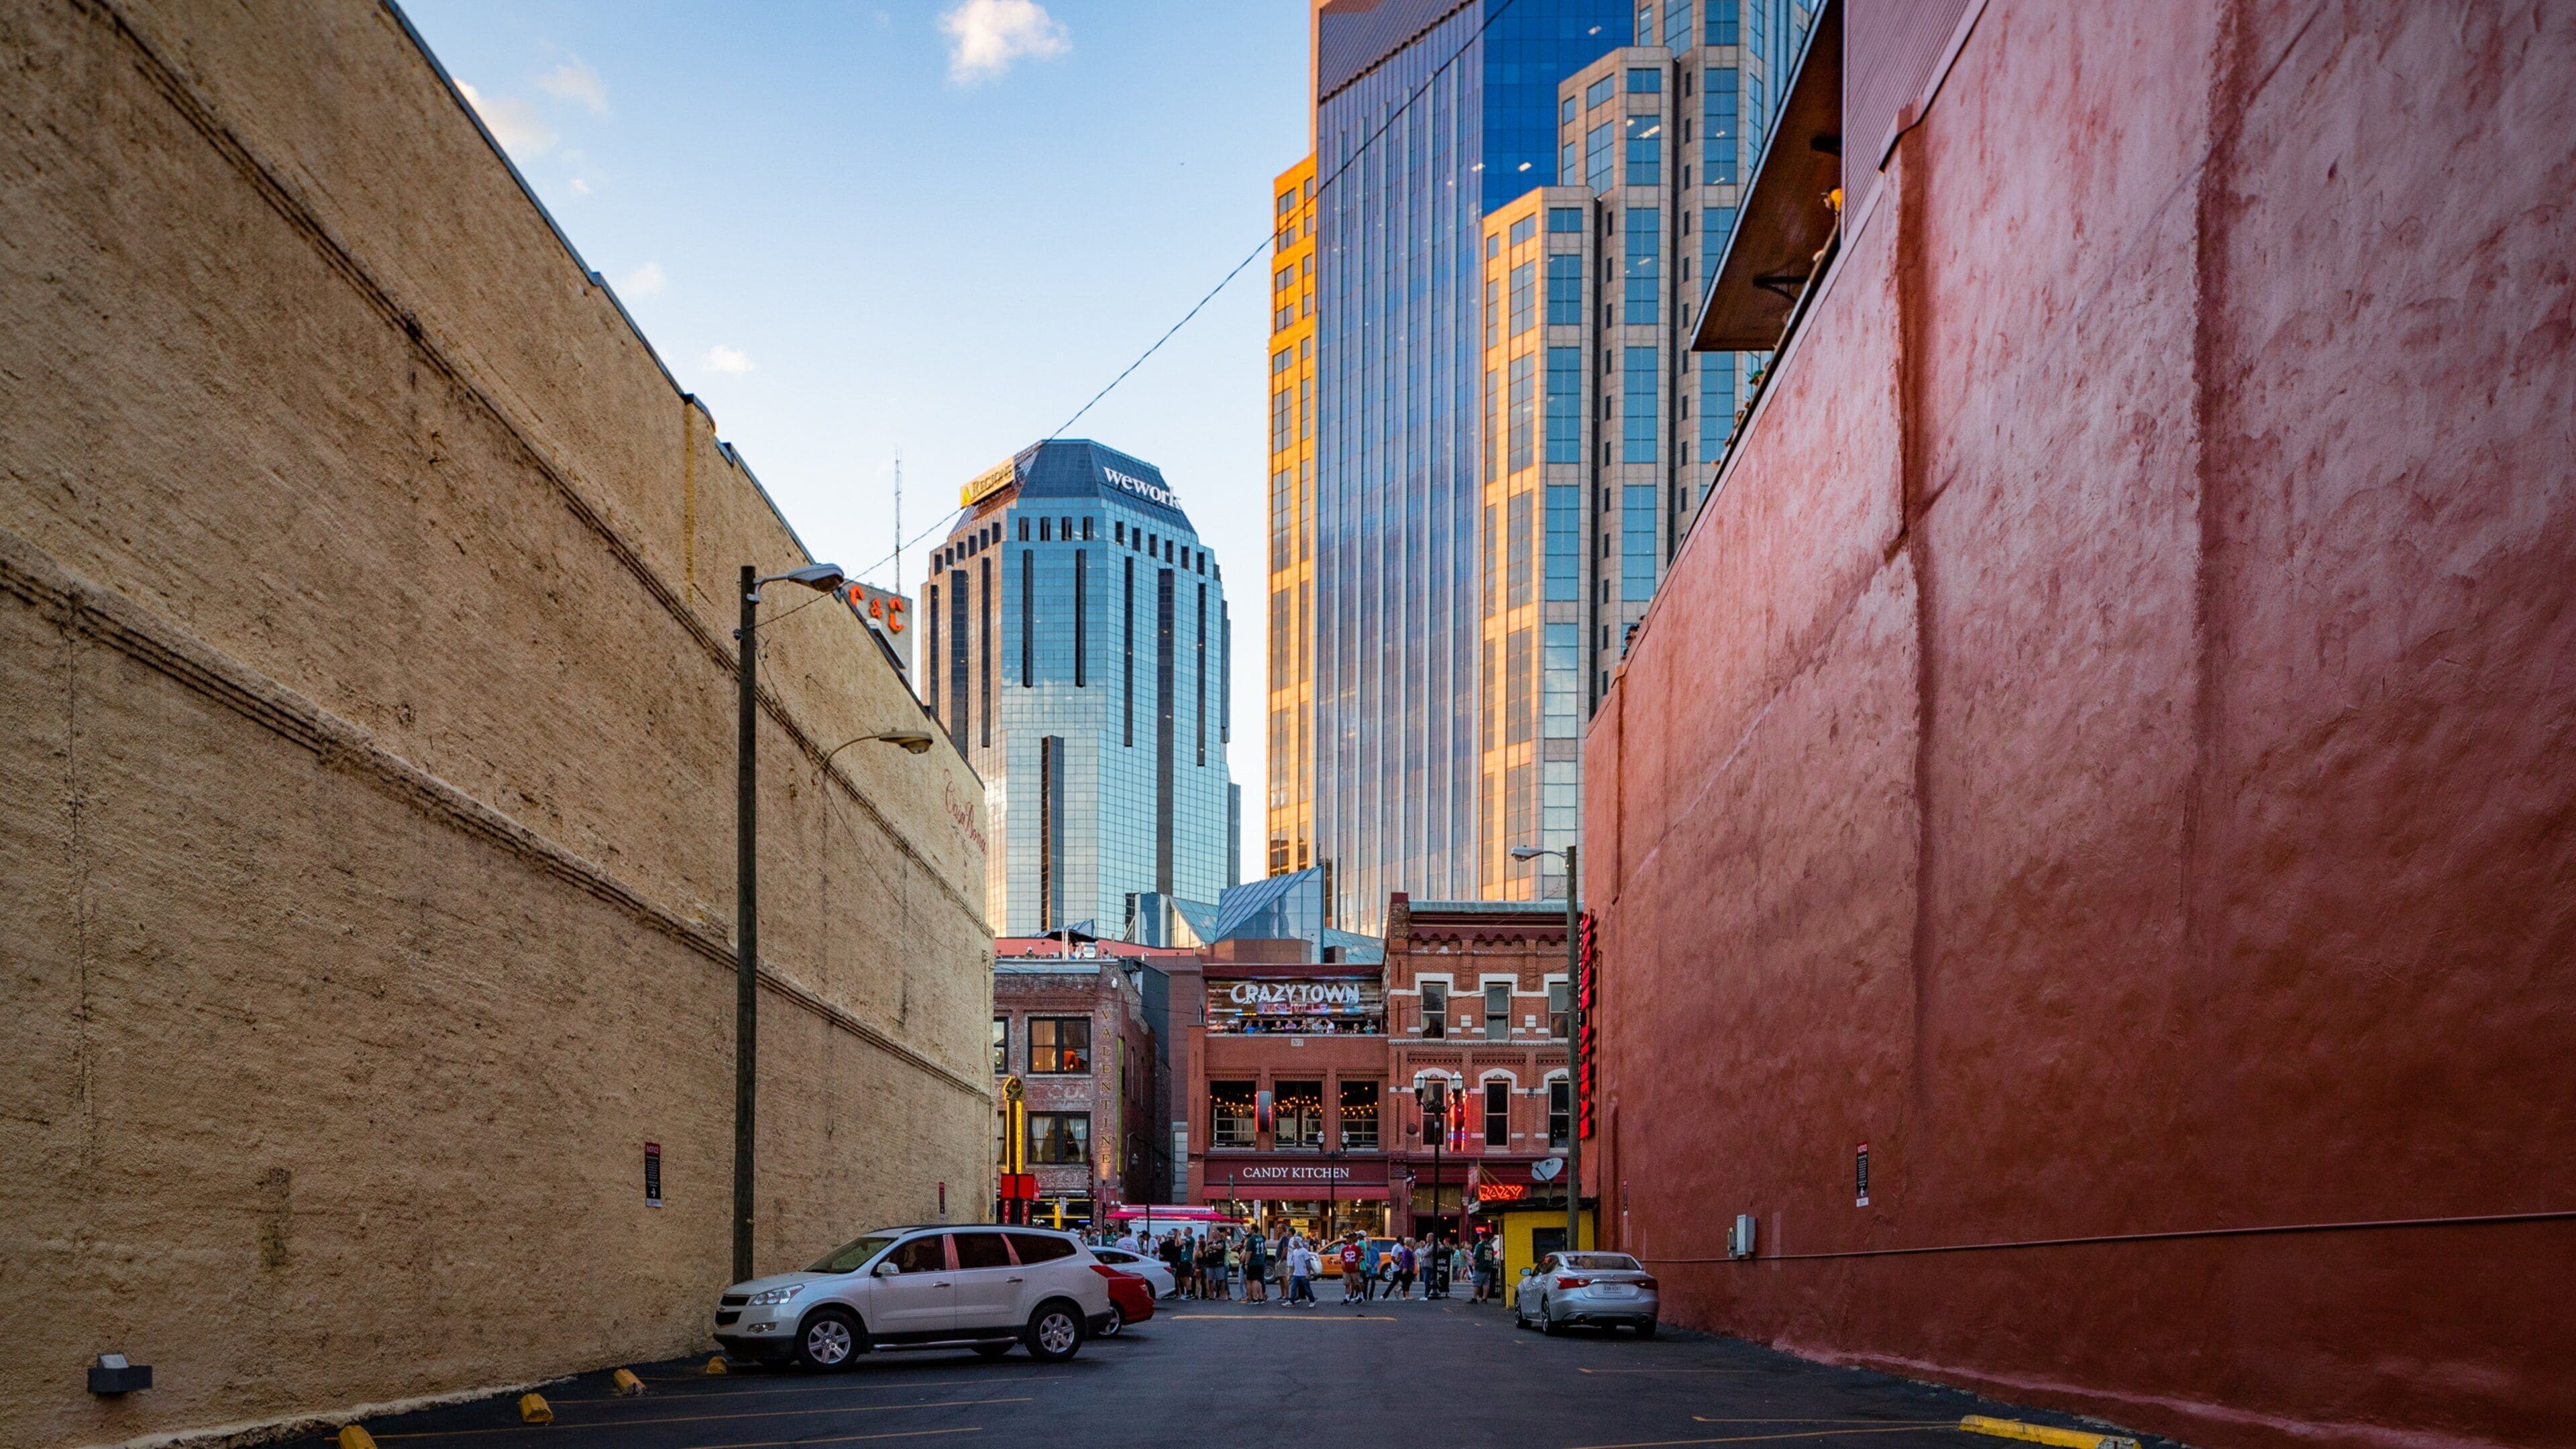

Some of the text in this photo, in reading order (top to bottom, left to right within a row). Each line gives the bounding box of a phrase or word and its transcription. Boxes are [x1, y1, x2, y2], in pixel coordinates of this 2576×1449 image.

[1103, 466, 1182, 508] wework
[1230, 983, 1360, 1005] CRAZYTOWN
[1100, 1008, 1113, 1164] VALENTINE
[1243, 1167, 1350, 1178] CANDY KITCHEN
